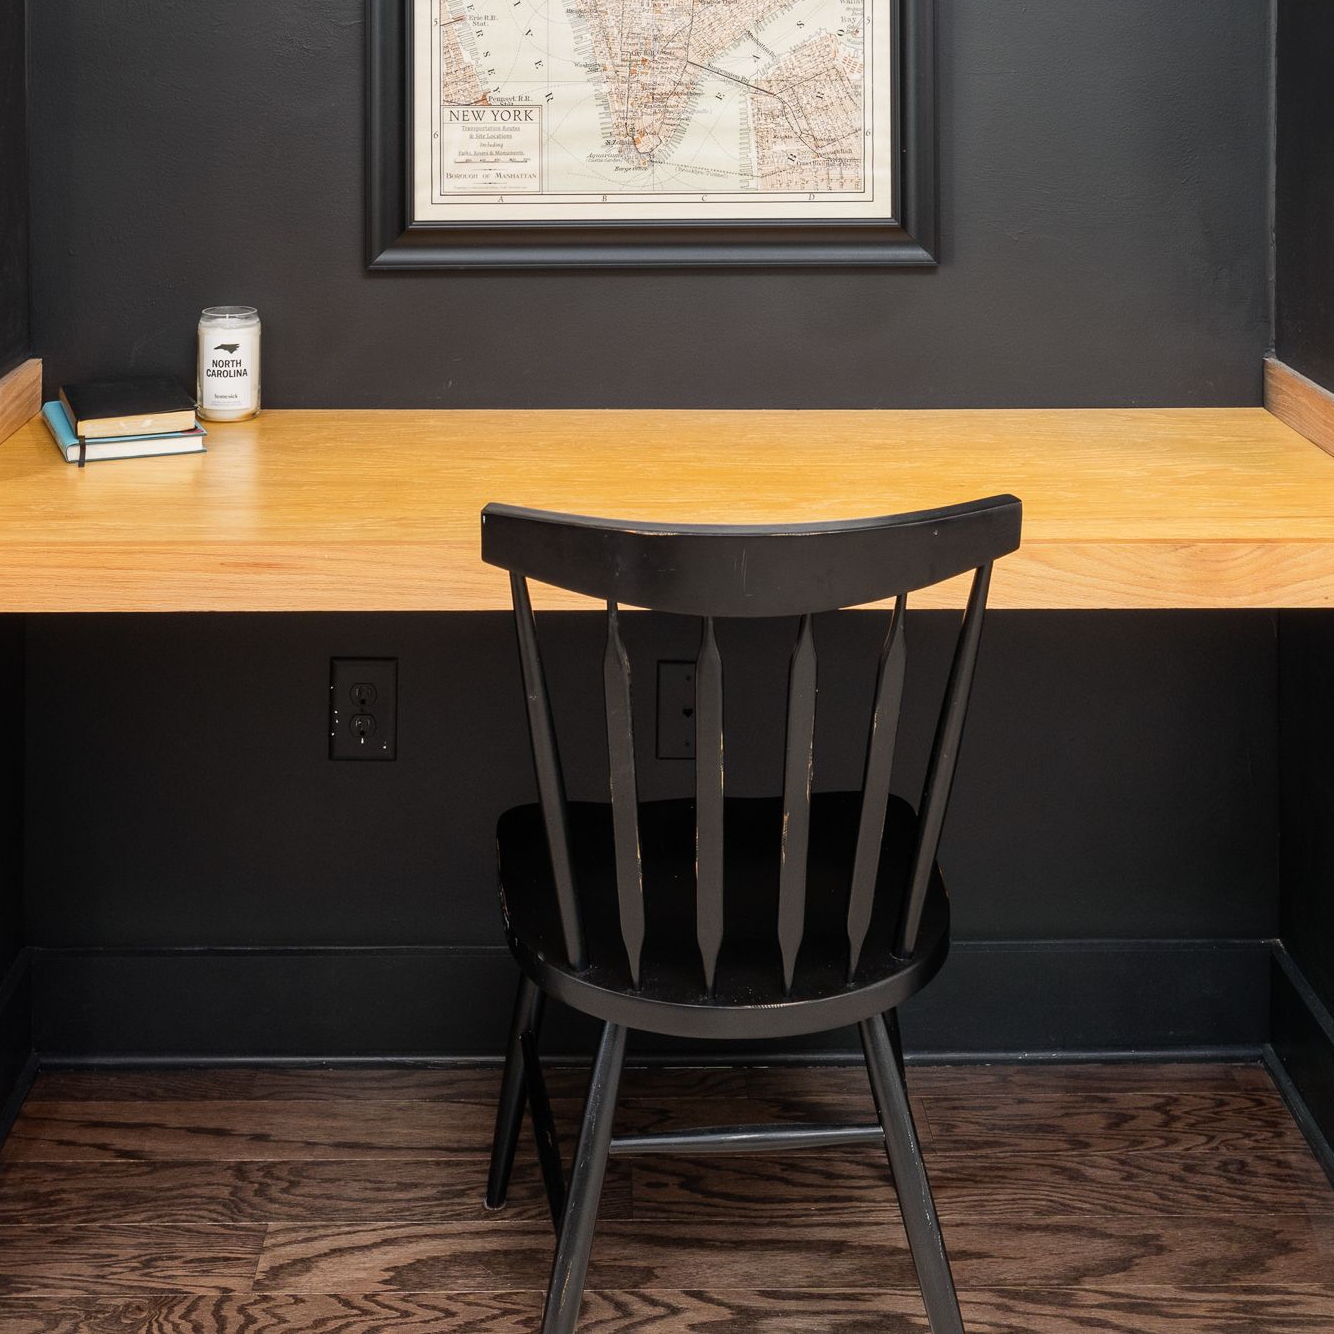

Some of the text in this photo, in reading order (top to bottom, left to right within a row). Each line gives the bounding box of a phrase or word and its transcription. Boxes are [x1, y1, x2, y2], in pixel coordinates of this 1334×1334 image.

[449, 109, 534, 122] NEW YORK
[212, 359, 242, 368] NORTH
[206, 368, 248, 378] CAROLINA
